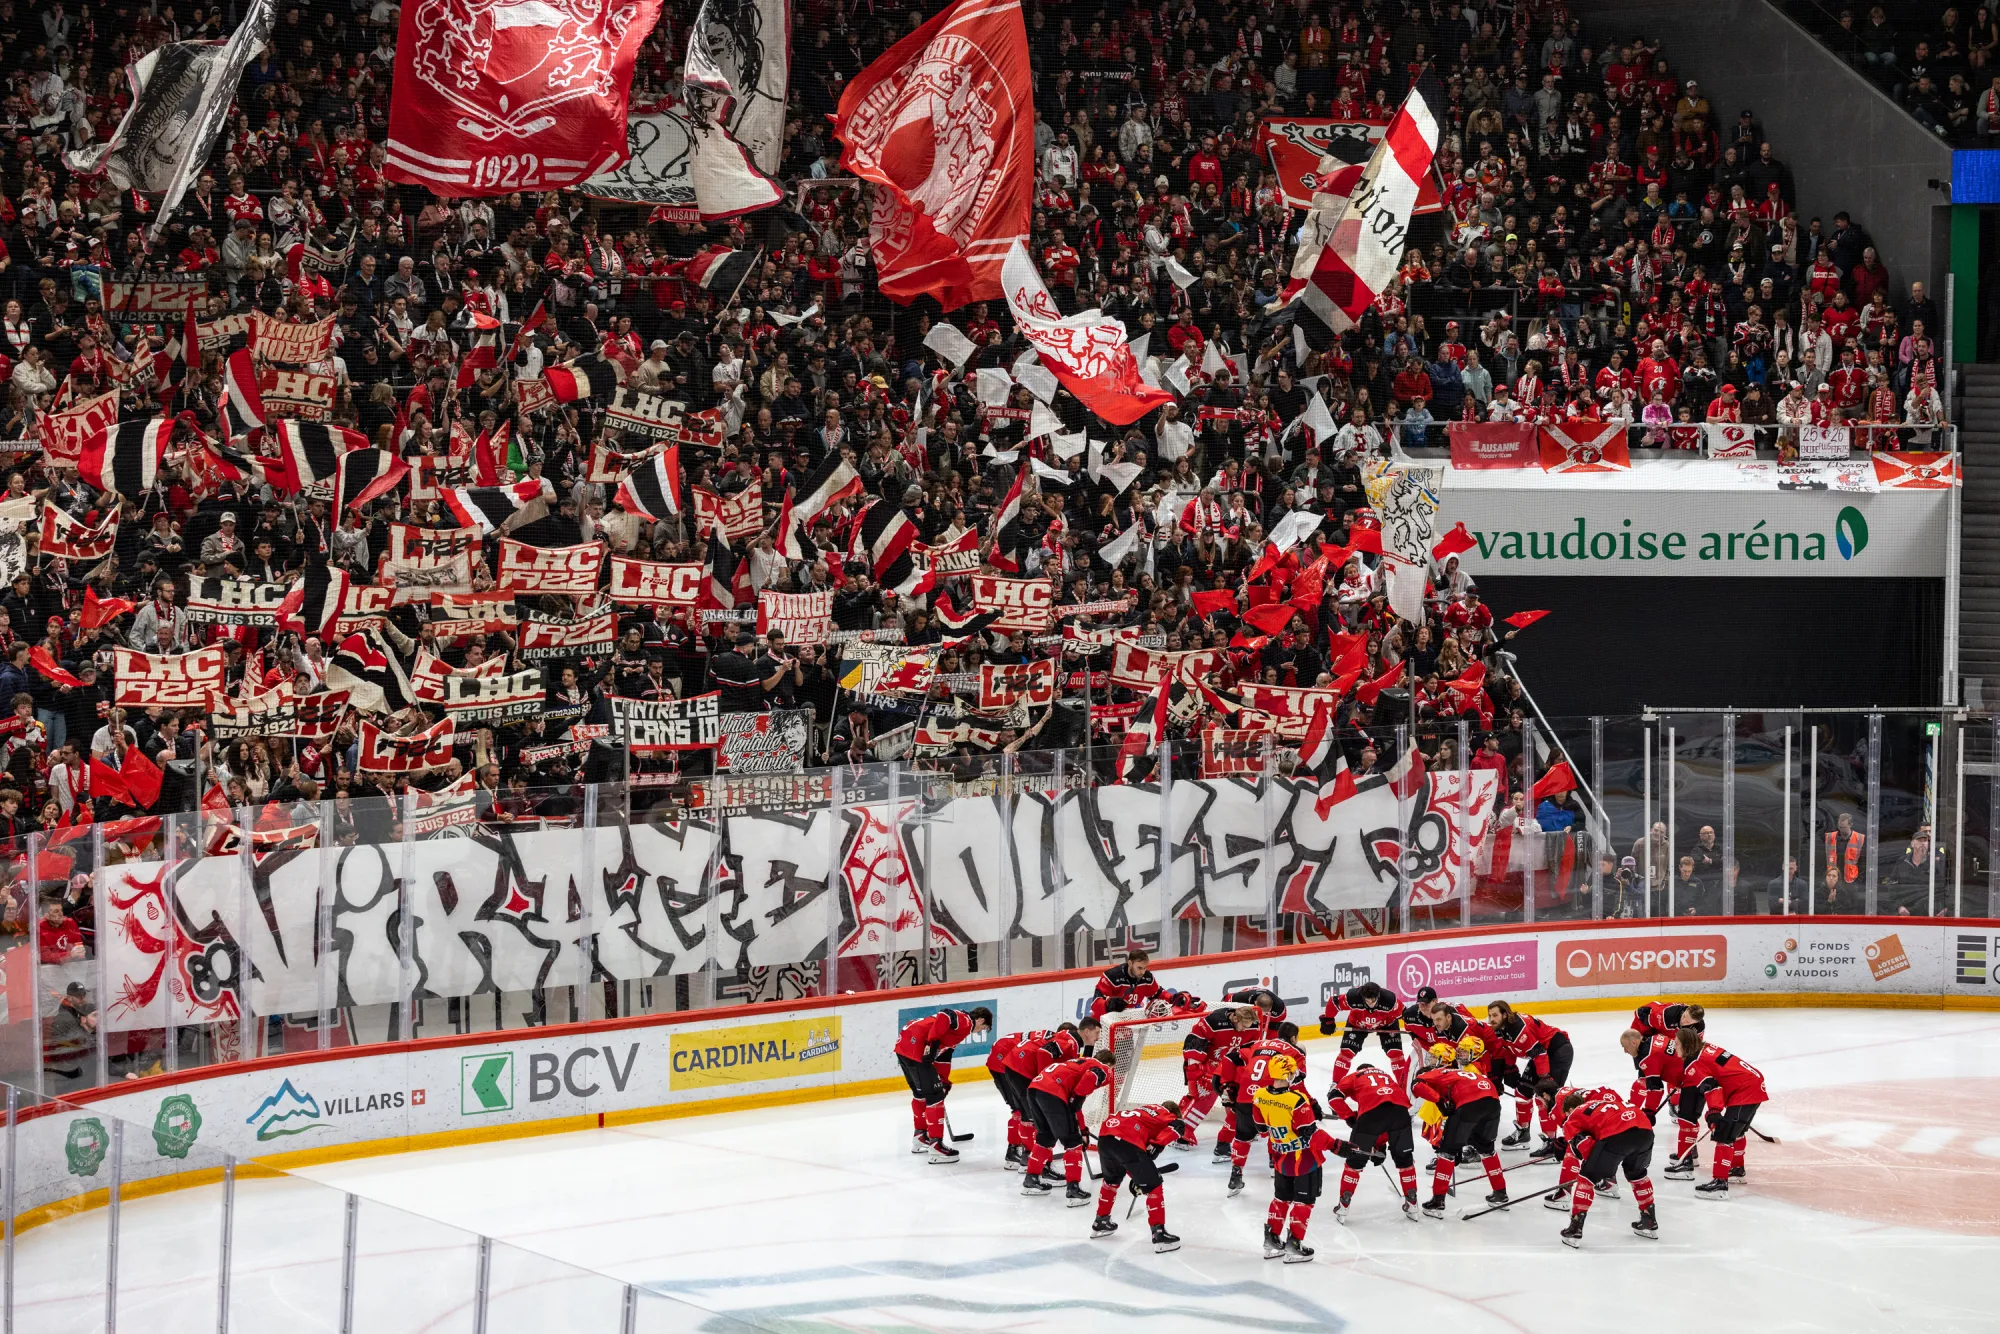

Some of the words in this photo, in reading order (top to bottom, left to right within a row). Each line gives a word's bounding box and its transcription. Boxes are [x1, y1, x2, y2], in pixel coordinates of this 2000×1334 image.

[472, 152, 540, 188] 1922
[239, 205, 250, 213] 92
[662, 209, 701, 223] LAUSANN
[111, 283, 208, 310] 1922
[1653, 365, 1664, 374] 20
[263, 403, 297, 414] PUIS
[607, 385, 686, 426] LHC
[604, 416, 649, 436] DEPUIS
[650, 427, 678, 440] 1922
[1803, 427, 1819, 442] 25
[1830, 426, 1845, 442] 26
[1475, 440, 1520, 453] LAUSANNE
[1712, 449, 1752, 459] TAMOIL
[1363, 519, 1373, 529] 7
[1472, 517, 1687, 561] vaudoise
[1698, 518, 1826, 561] aréna
[501, 542, 601, 572] LHC
[500, 570, 596, 590] 1922
[611, 561, 702, 600] LHC
[188, 574, 286, 609] LHC
[973, 578, 1051, 608] LHC
[188, 609, 244, 625] DEPUIS
[247, 613, 279, 626] 192
[1001, 606, 1049, 627] 22
[433, 619, 486, 637] 1922
[524, 613, 613, 647] 1922
[522, 646, 578, 660] HOCKEY
[579, 641, 615, 655] CLUB
[849, 651, 873, 659] JENA
[115, 648, 222, 682] LHC
[1112, 643, 1215, 687] LHC
[446, 668, 544, 703] LHC
[981, 660, 1053, 708] LHC
[993, 671, 1043, 693] 1922
[1070, 675, 1096, 686] ouet
[506, 702, 541, 716] 1922
[686, 694, 719, 719] LES
[263, 718, 296, 735] 1922
[699, 717, 719, 745] ID
[446, 809, 475, 826] 1922
[1810, 942, 1850, 951] FONDS
[1598, 948, 1716, 972] MYSPORTS
[1798, 956, 1816, 965] DU
[1819, 956, 1856, 965] SPORT
[1873, 960, 1910, 979] ROMANDE
[1877, 954, 1909, 970] LOTERIE
[1335, 963, 1351, 984] bla
[1434, 977, 1455, 987] Loisirs
[1463, 974, 1493, 985] bien-être
[1494, 973, 1510, 983] pour
[1511, 971, 1526, 981] tous
[1785, 969, 1839, 978] VAUDOIS
[1128, 993, 1138, 1005] 29
[1229, 1035, 1243, 1047] 33
[672, 1039, 795, 1073] CARDINAL
[801, 1042, 838, 1060] CARDINAL
[529, 1042, 640, 1103] BCV
[1251, 1058, 1267, 1082] 9
[1366, 1075, 1391, 1087] 17
[324, 1090, 405, 1117] VILLARS
